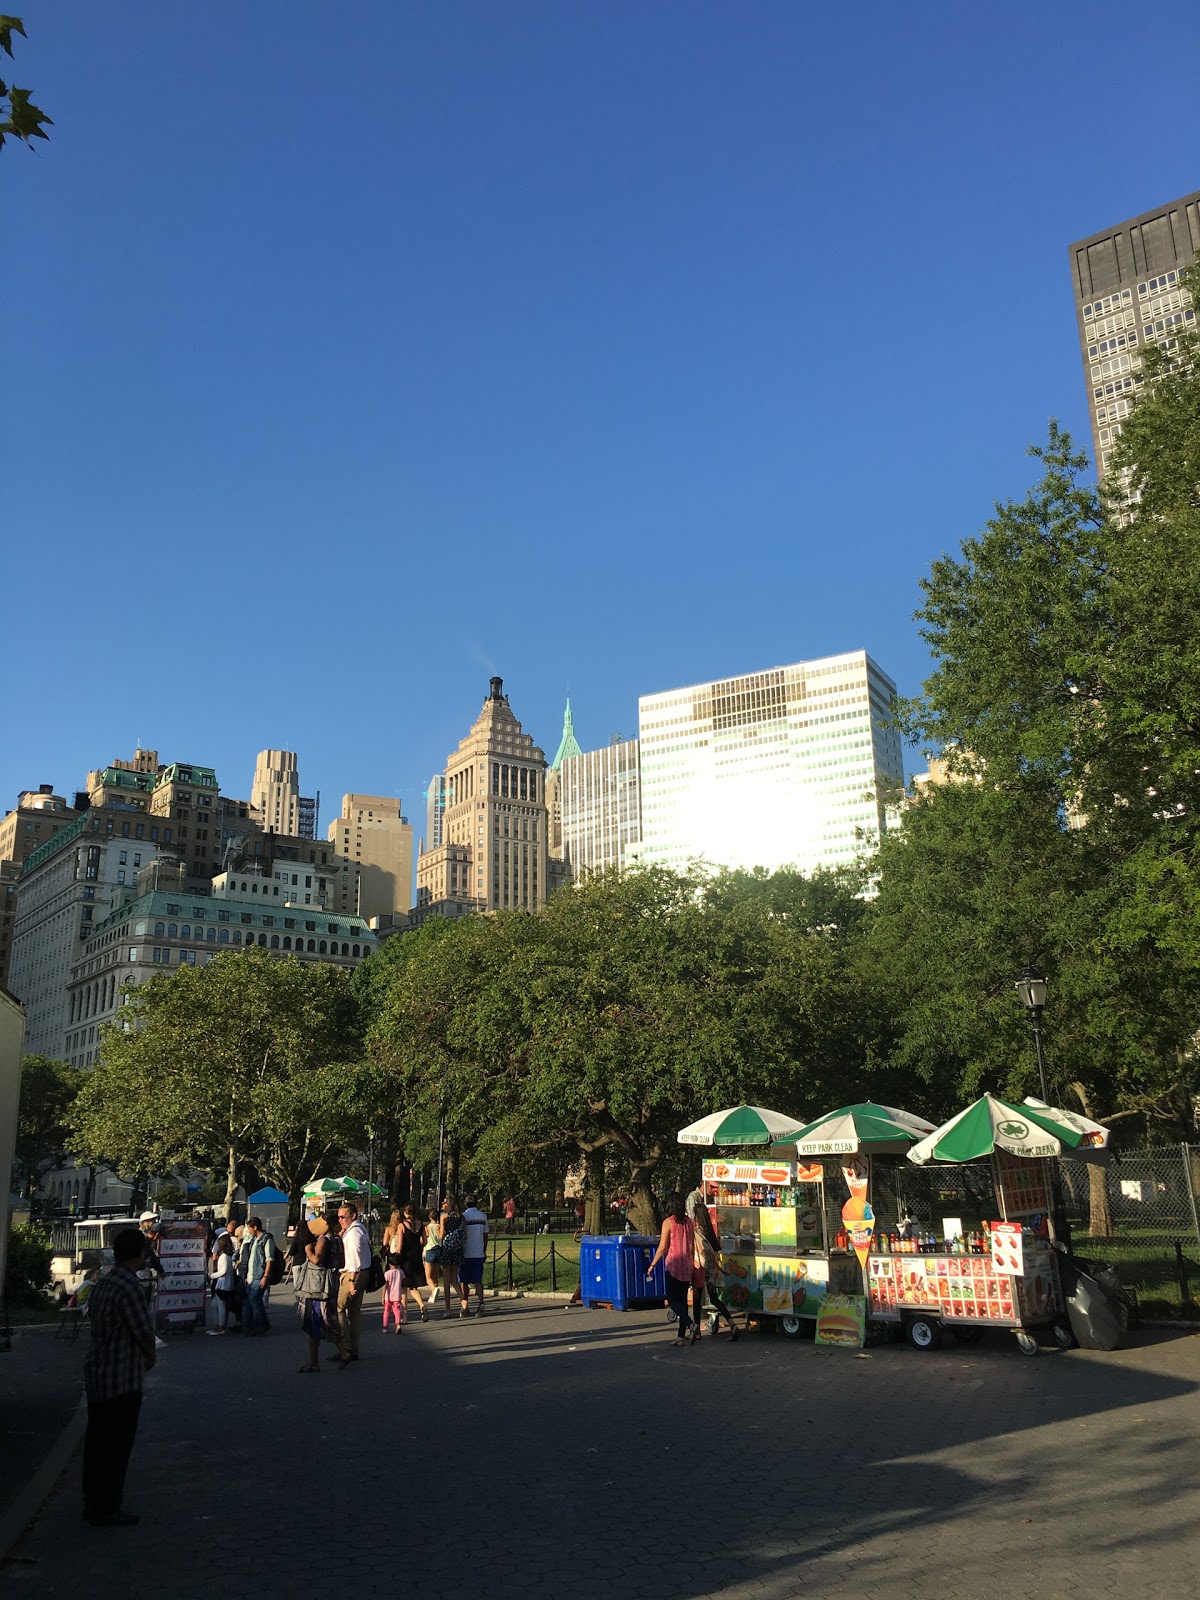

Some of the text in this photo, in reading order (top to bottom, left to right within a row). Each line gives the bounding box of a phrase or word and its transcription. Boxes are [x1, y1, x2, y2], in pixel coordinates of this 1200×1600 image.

[802, 1142, 853, 1153] KEEP PARK CLEAN
[1017, 1146, 1035, 1156] PARK
[1035, 1144, 1056, 1156] CLEAN
